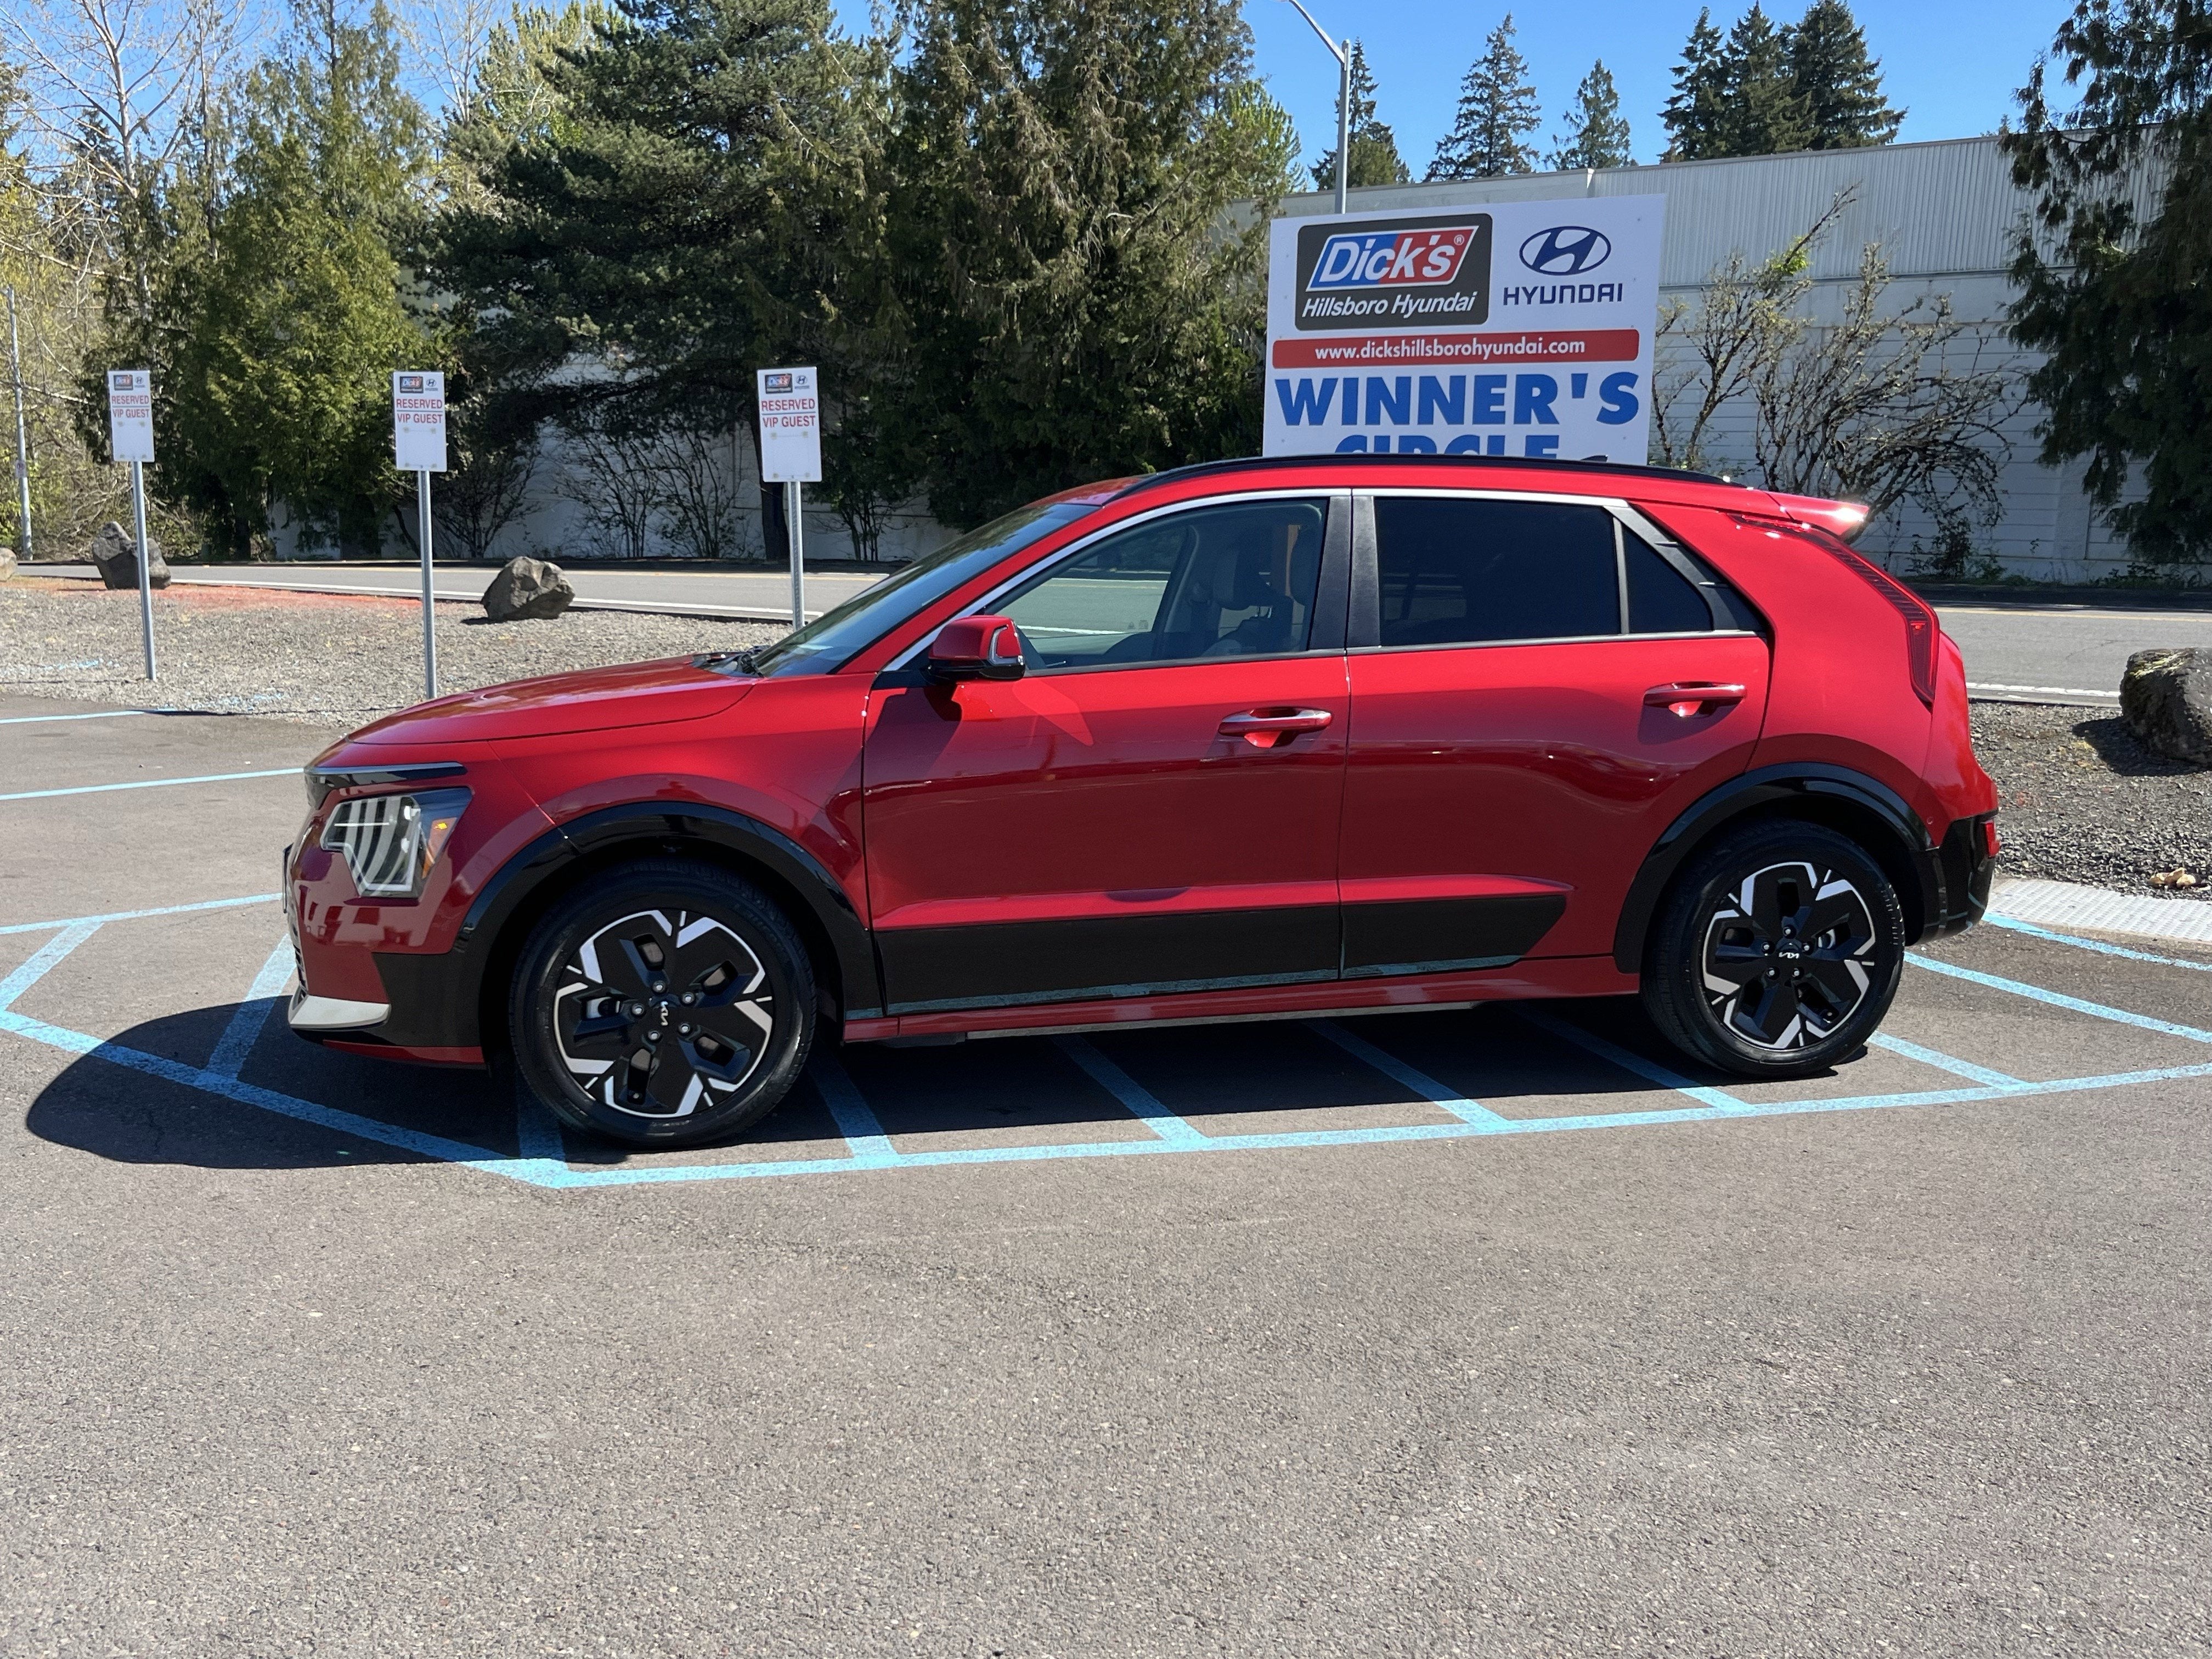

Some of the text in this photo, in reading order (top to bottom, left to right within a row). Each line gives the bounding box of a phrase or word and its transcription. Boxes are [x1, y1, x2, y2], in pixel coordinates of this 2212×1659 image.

[1503, 283, 1623, 306] HYUNDAI
[1301, 291, 1478, 319] Hillsboro Hyundai
[1315, 336, 1585, 360] www.dickshillsborohyundai.com
[111, 395, 149, 405] RESERVED
[396, 398, 443, 409] RESERVED
[761, 398, 815, 411] RESERVED
[1274, 371, 1639, 426] WINNER'S
[112, 409, 150, 418] VIP GUEST
[397, 413, 443, 424] VIP GUEST
[763, 415, 816, 428] VIP GUEST
